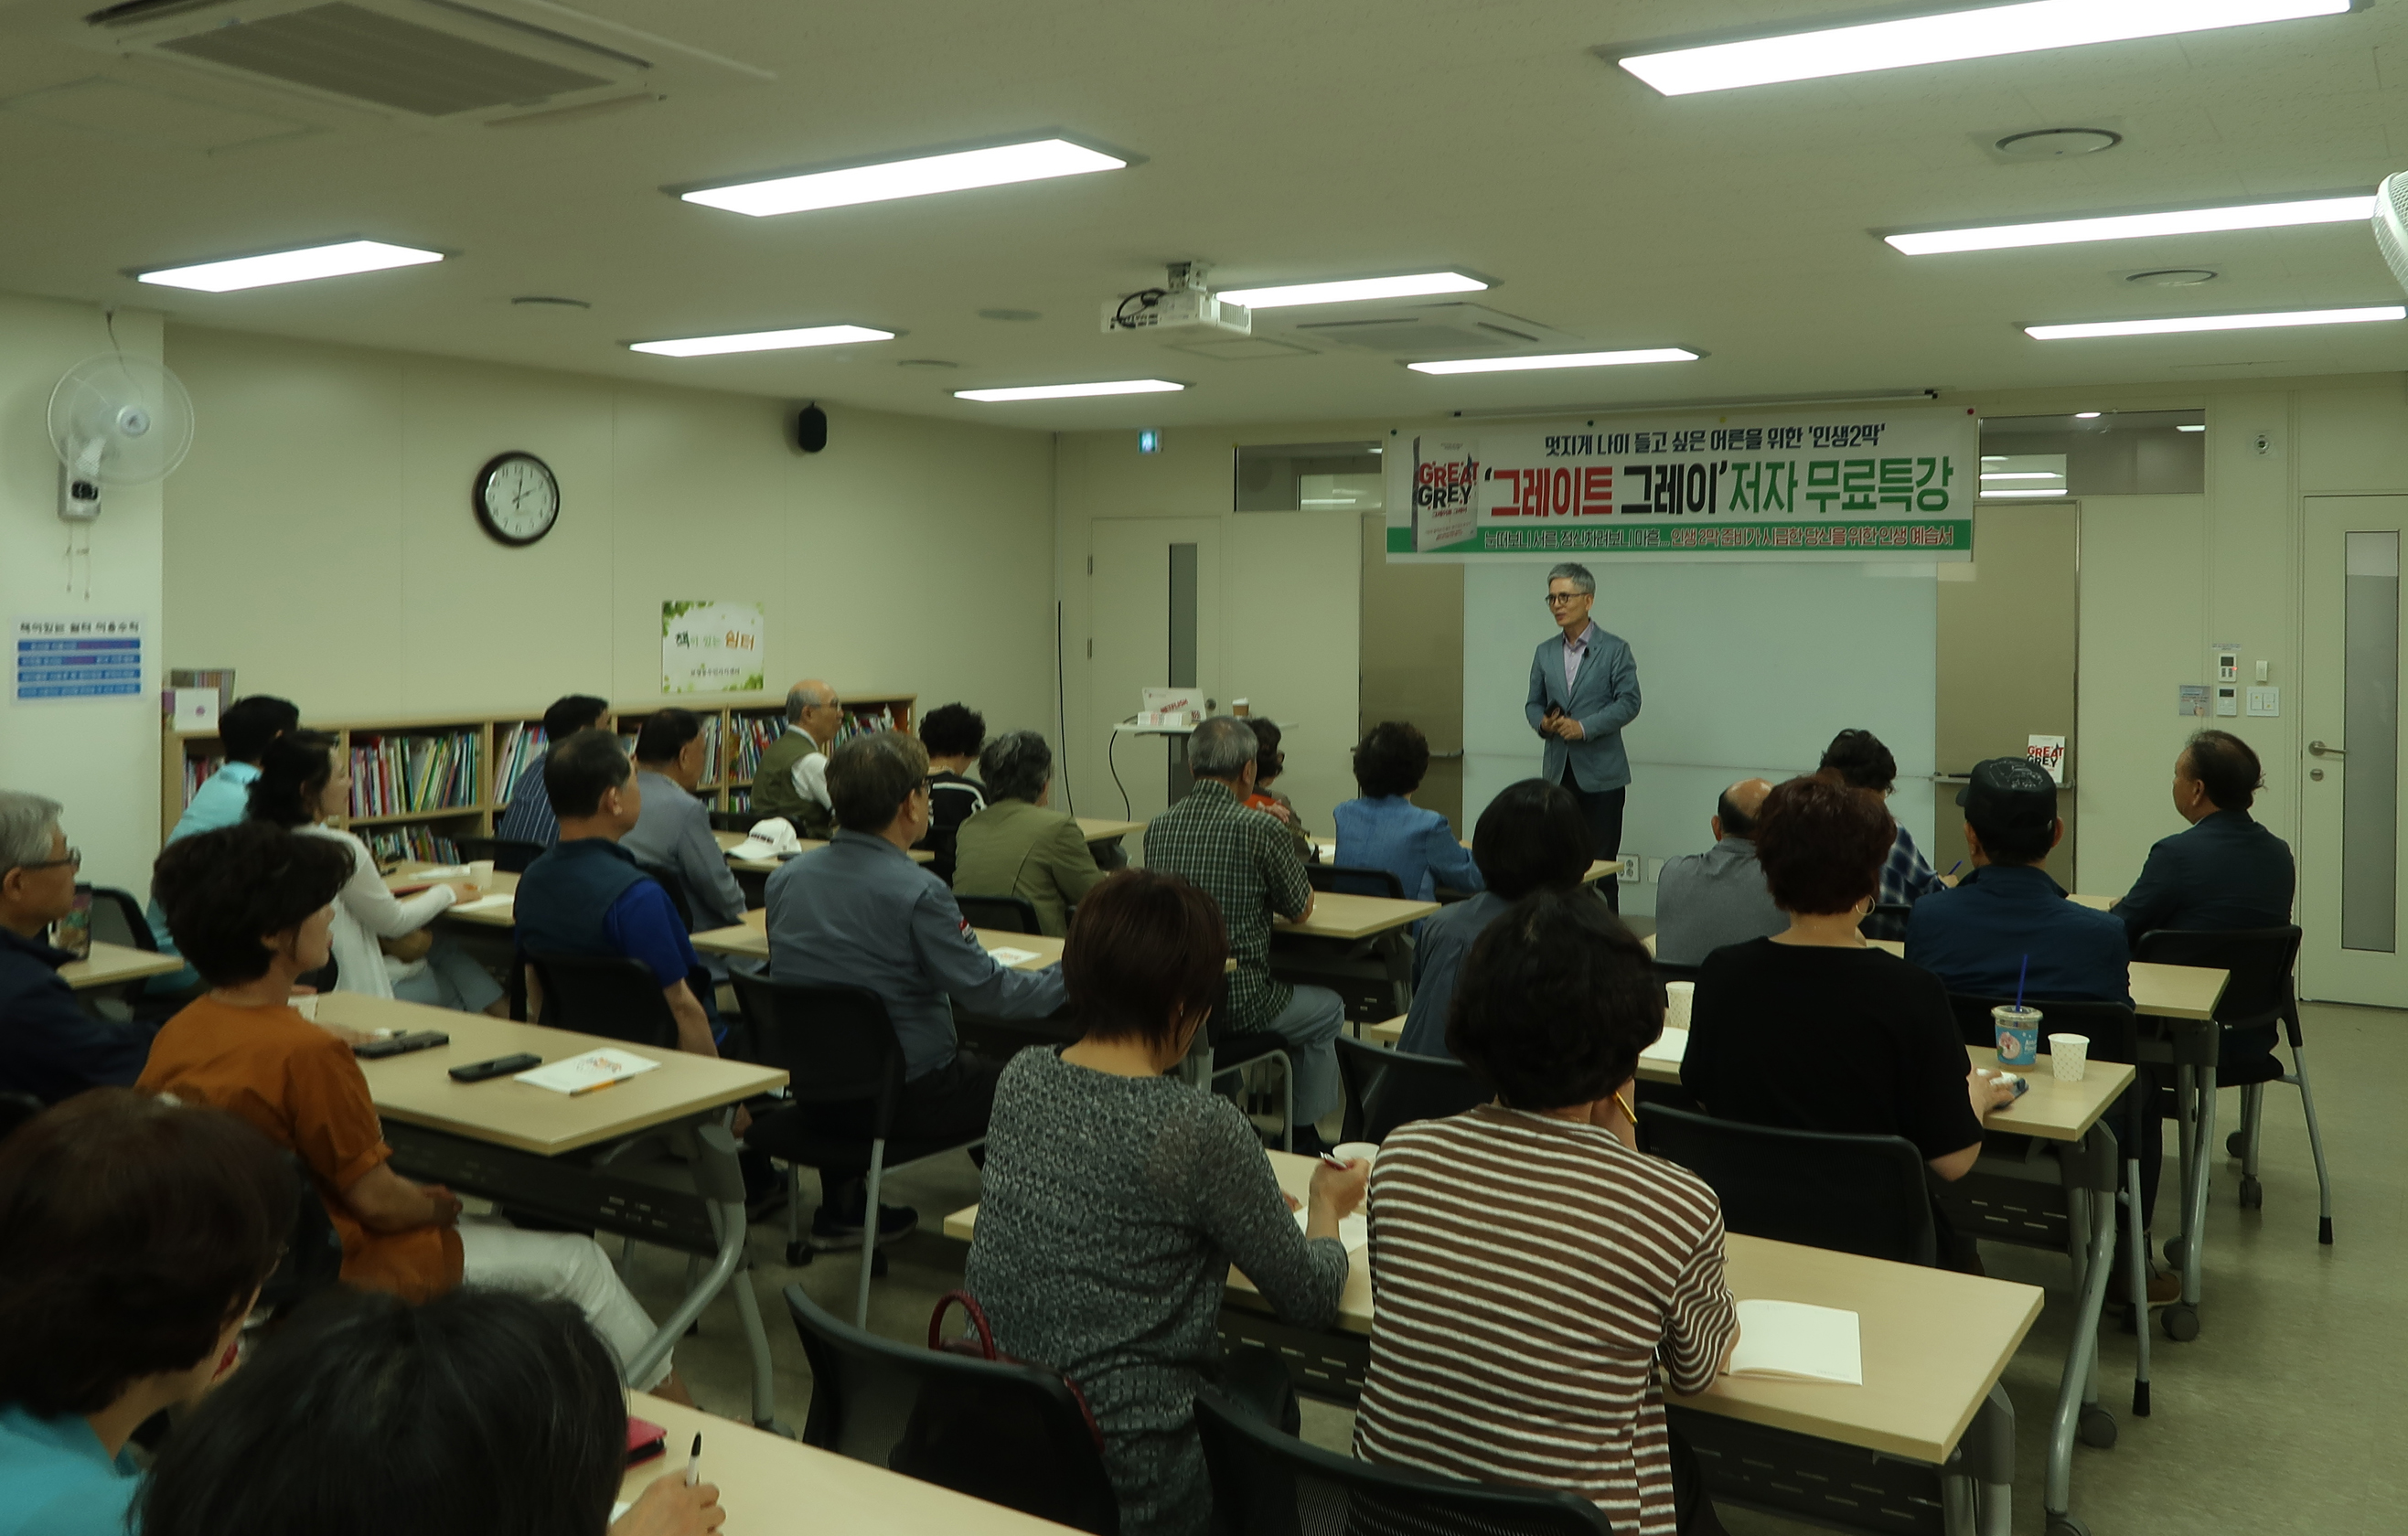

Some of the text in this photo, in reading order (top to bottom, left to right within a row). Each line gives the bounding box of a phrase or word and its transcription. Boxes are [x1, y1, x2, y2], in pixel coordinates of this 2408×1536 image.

[1545, 434, 1593, 457] 멋지게
[1598, 433, 1630, 455] 나이
[1634, 432, 1667, 453] 들고
[1672, 430, 1707, 453] 싶은
[1710, 429, 1763, 451] 어른을
[1767, 426, 1803, 449] 위한
[1419, 461, 1480, 487] GREAT
[1728, 460, 1798, 514] 저자
[1805, 455, 1953, 514] 무료특강
[1418, 485, 1472, 509] GREY
[1671, 528, 1696, 547] 인생
[1698, 528, 1719, 547] 2막
[1910, 525, 1953, 546] 예습서
[2027, 745, 2064, 758] GREAT
